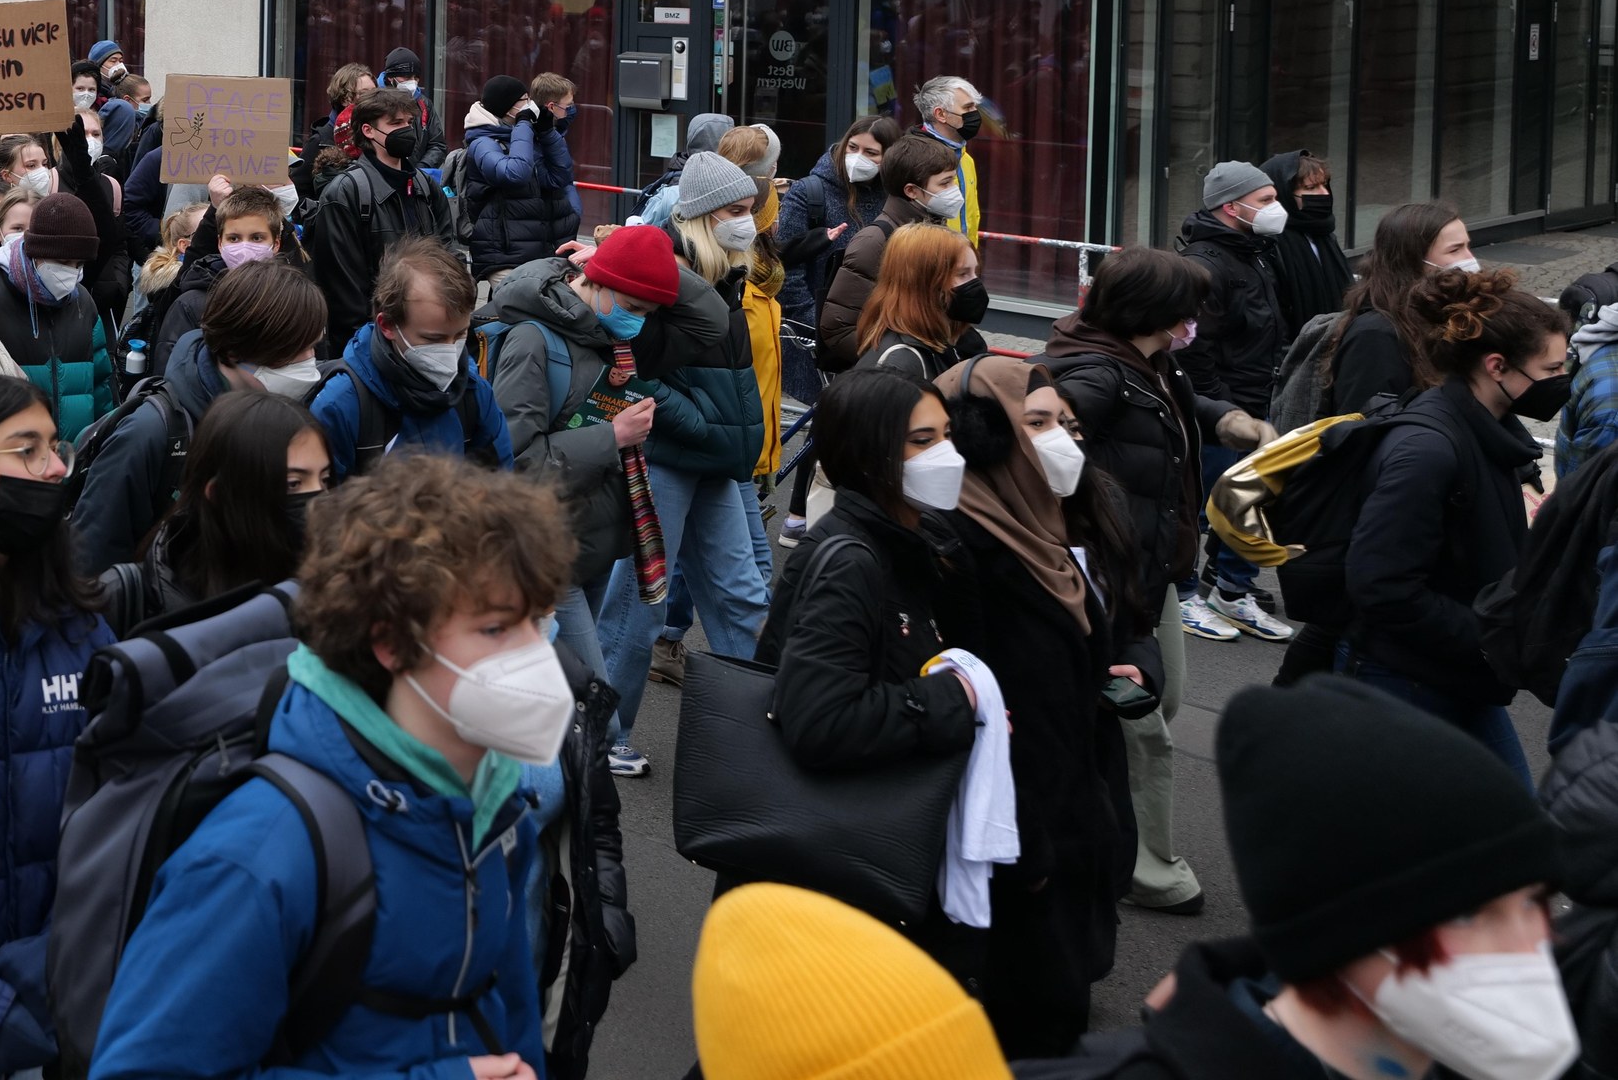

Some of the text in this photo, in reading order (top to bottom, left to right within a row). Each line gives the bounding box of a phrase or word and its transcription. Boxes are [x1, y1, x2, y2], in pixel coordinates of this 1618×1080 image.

[21, 22, 59, 46] viele
[186, 83, 285, 124] PEACE
[208, 128, 256, 149] FOR
[167, 150, 280, 178] UKRAINE
[625, 389, 645, 400] WARUM
[596, 402, 623, 413] LEBEN
[42, 673, 79, 704] HH
